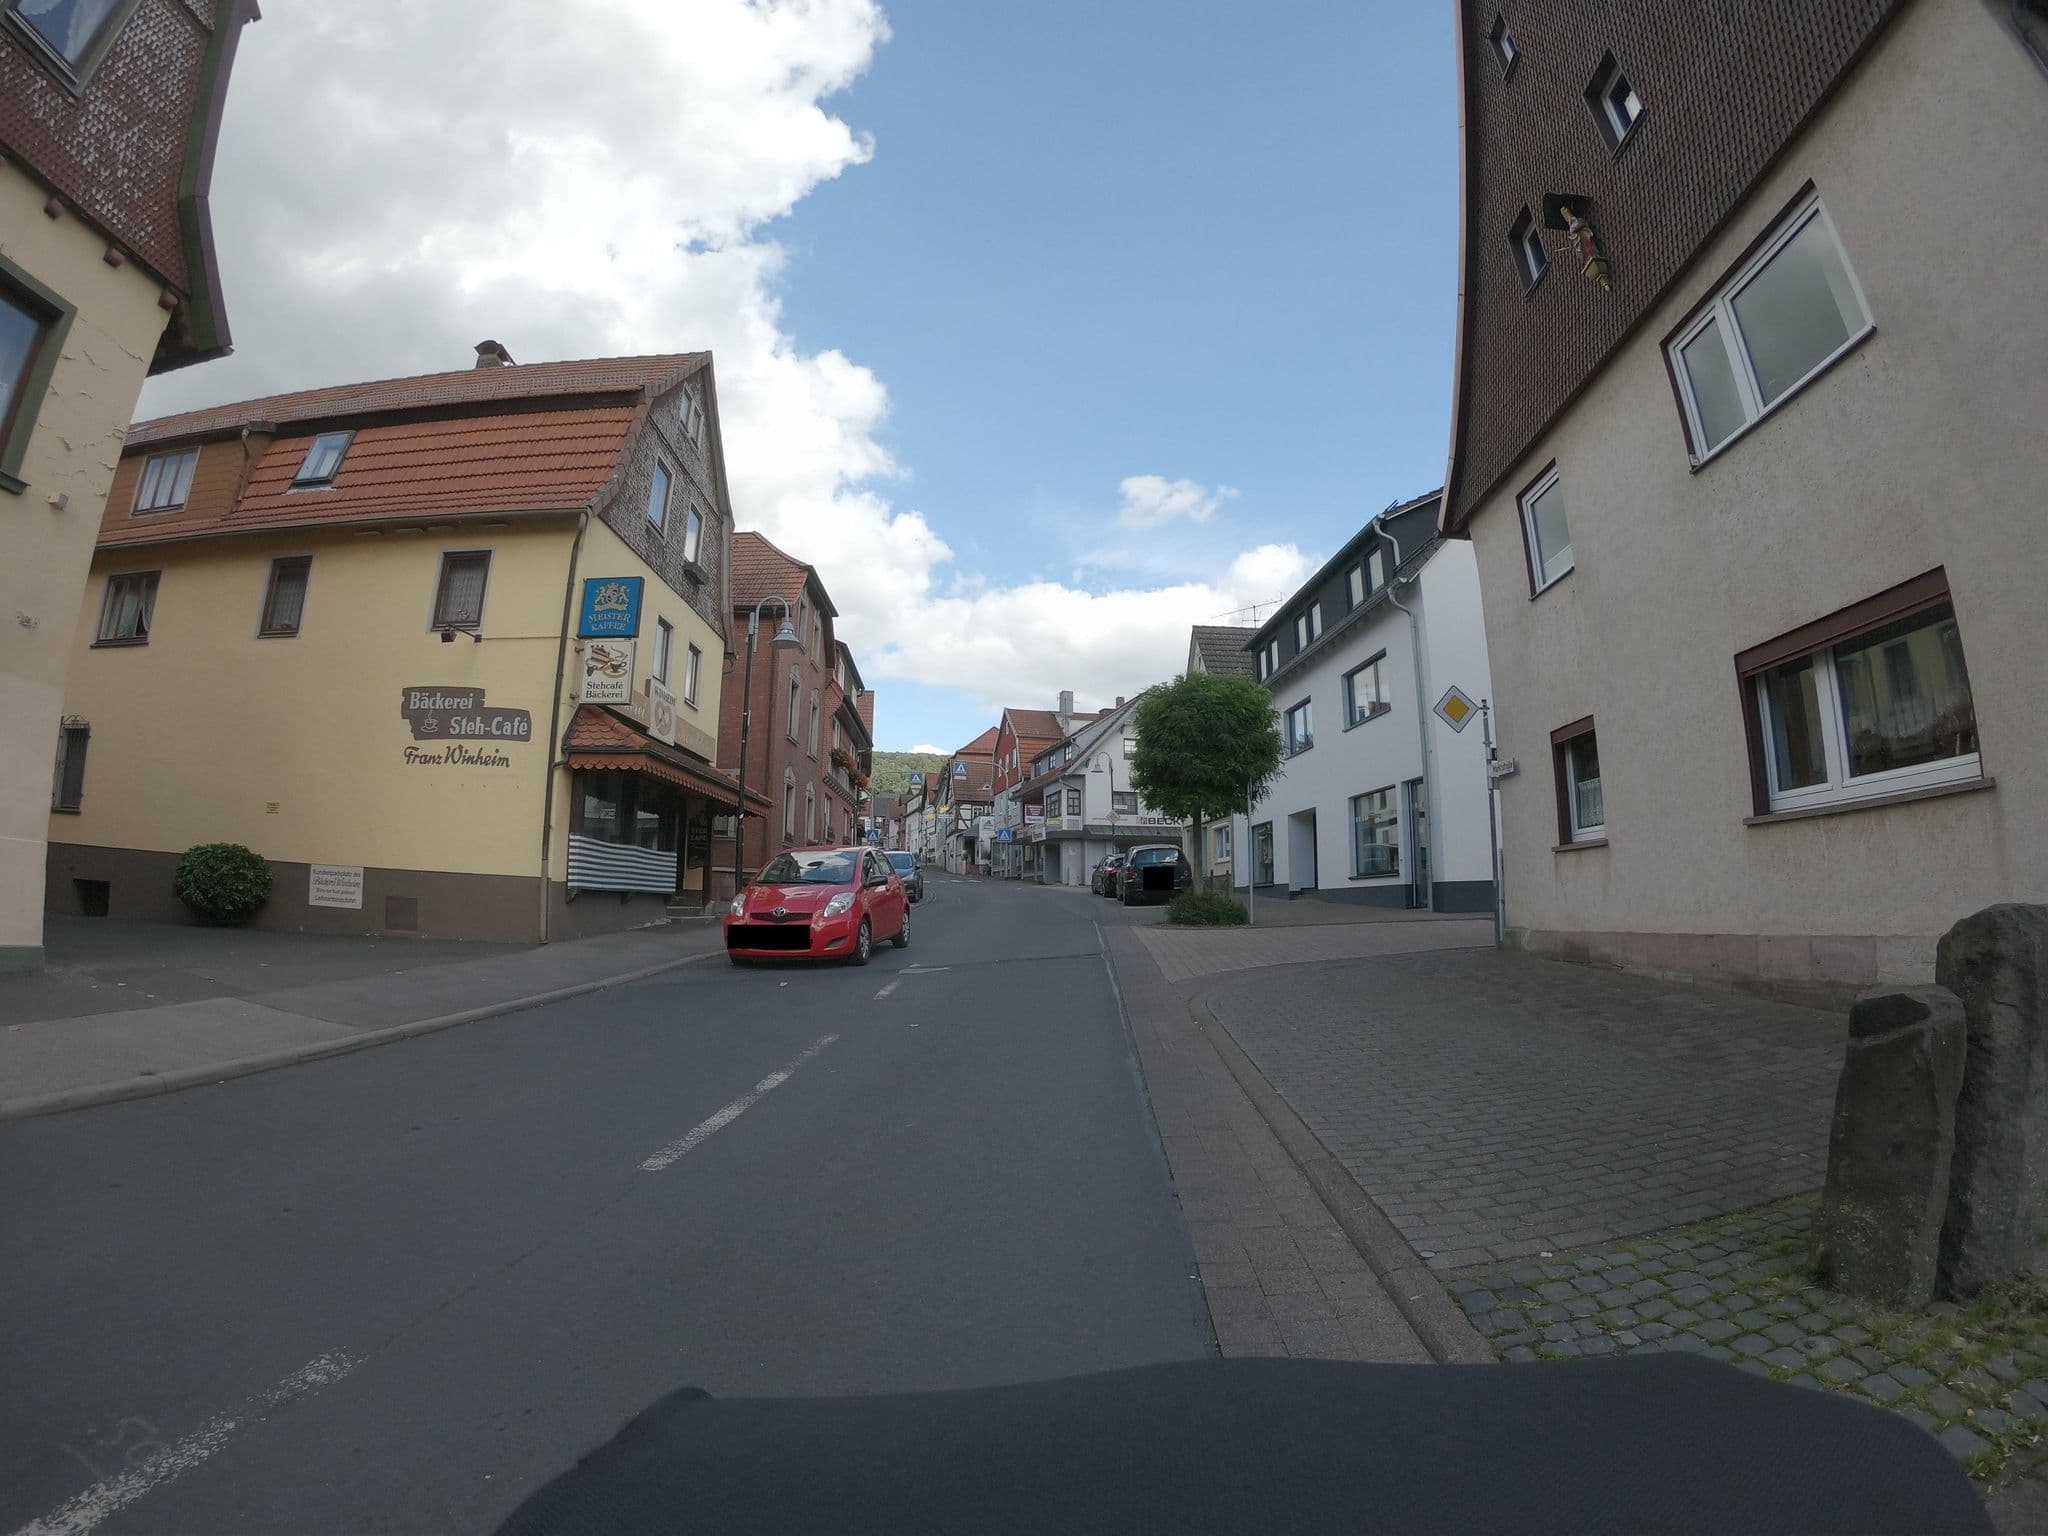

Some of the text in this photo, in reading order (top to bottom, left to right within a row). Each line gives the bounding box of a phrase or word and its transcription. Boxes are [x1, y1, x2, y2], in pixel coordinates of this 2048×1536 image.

[588, 613, 631, 623] MEISTER
[591, 622, 627, 631] KAFFEE
[586, 681, 624, 690] Stehcafé
[409, 691, 474, 710] Bäckerei
[585, 690, 624, 699] Bäckerei
[654, 686, 676, 706] WINHEIM
[449, 716, 529, 736] Steh-Café
[404, 743, 511, 769] Franz Winheim
